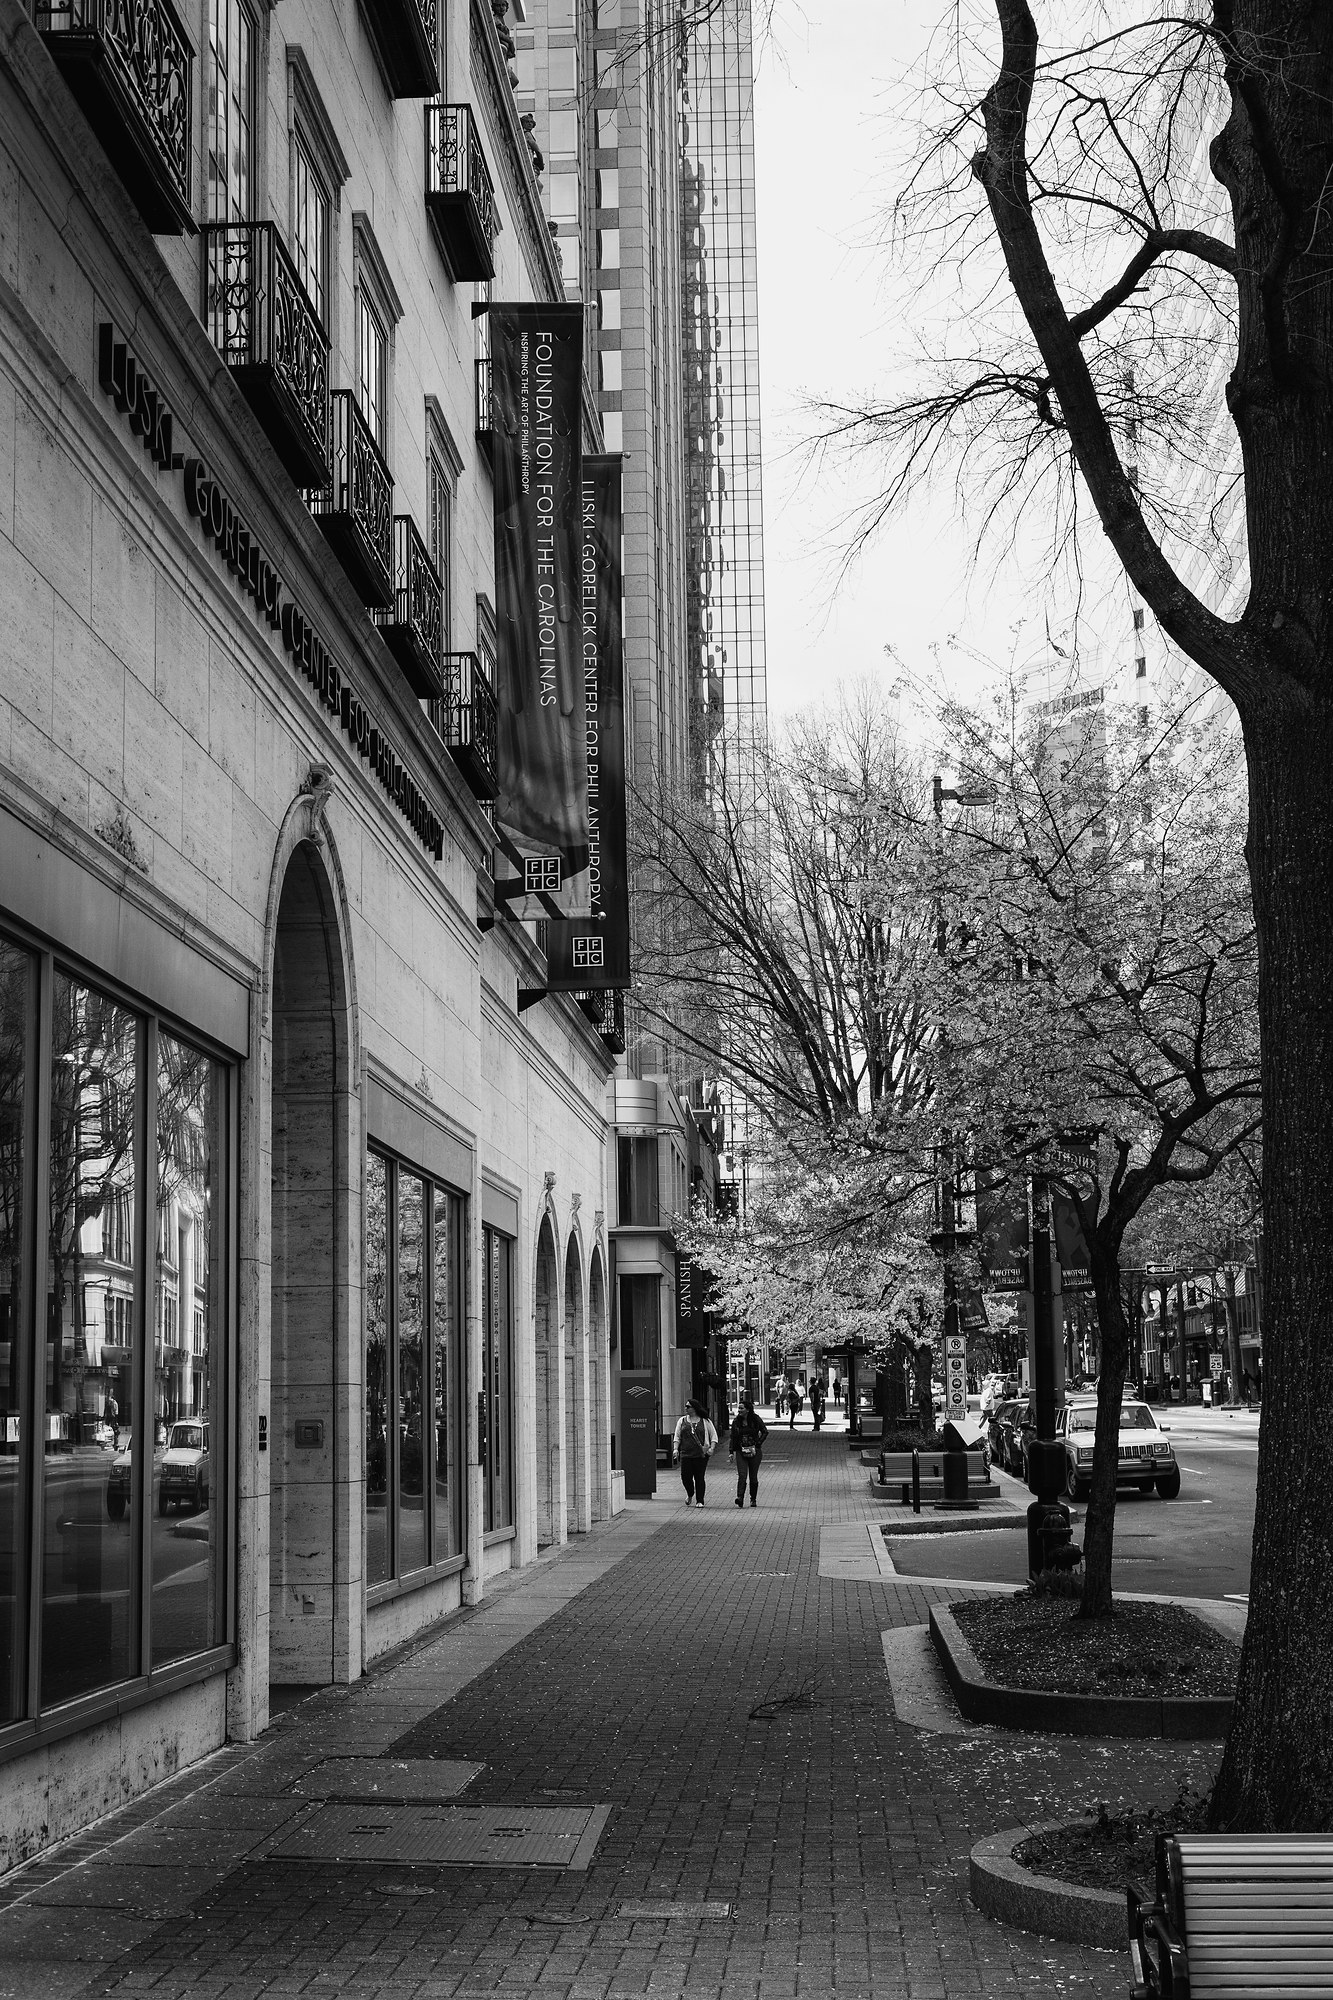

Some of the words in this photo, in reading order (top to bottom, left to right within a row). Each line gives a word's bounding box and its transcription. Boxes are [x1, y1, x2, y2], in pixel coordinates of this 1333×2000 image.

[521, 332, 529, 376] INSPIRING
[521, 377, 529, 395] THE
[521, 396, 529, 413] ART
[536, 332, 553, 475] FOUNDATION
[521, 415, 529, 428] OF
[521, 429, 530, 495] PHILANTHROPY
[537, 484, 555, 528] FOR
[537, 534, 554, 575] THE
[582, 544, 597, 636] GORELICK
[183, 458, 284, 630] GORELICK
[282, 603, 341, 716] CENTER
[341, 687, 370, 758] FOR
[370, 729, 445, 861] PHILANTHROPY
[538, 584, 557, 707] CAROLINAS
[583, 643, 598, 713] CENTER
[585, 720, 599, 757] FOR
[680, 1260, 691, 1318] SPANISH
